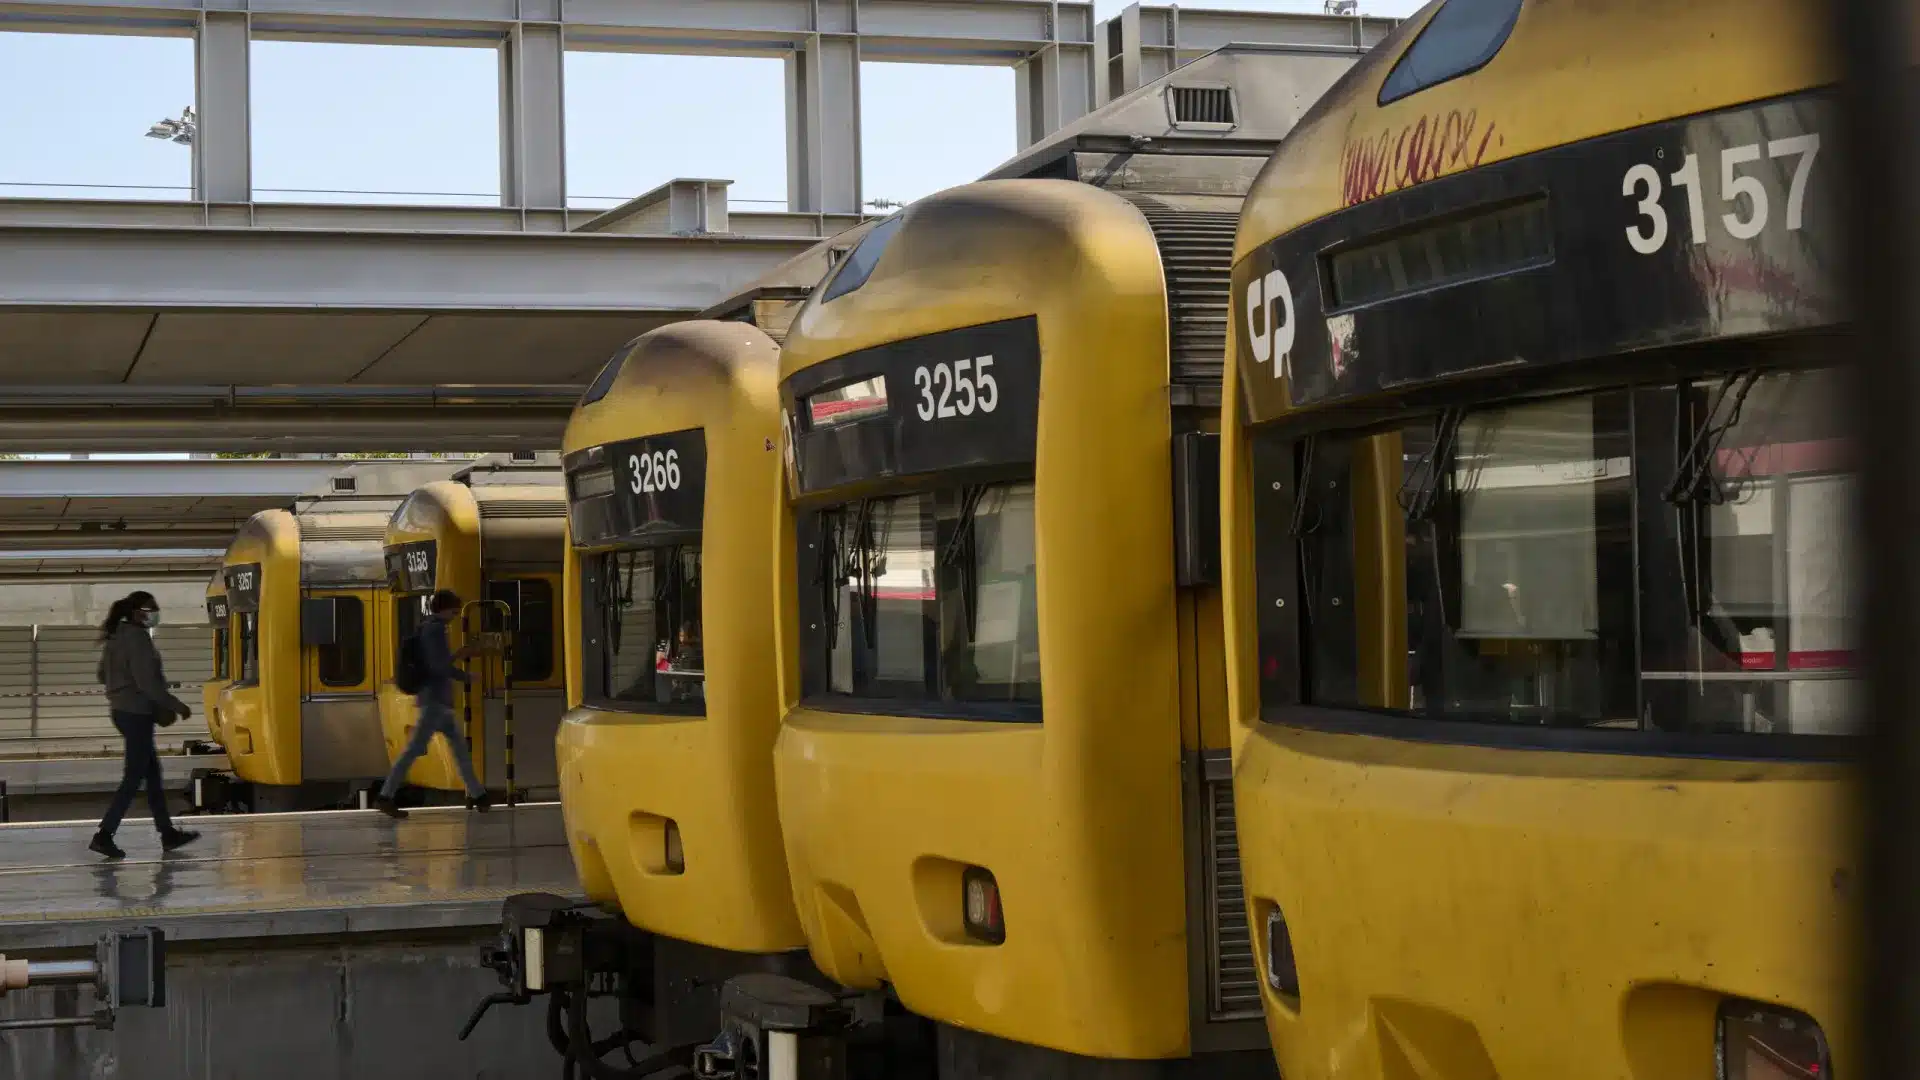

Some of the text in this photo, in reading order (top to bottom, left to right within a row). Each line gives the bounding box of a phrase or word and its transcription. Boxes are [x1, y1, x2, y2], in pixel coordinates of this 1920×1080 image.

[1622, 132, 1820, 254] 3157
[914, 354, 998, 422] 3255
[629, 448, 681, 495] 3266
[237, 571, 253, 591] 3267
[406, 550, 429, 572] 3158
